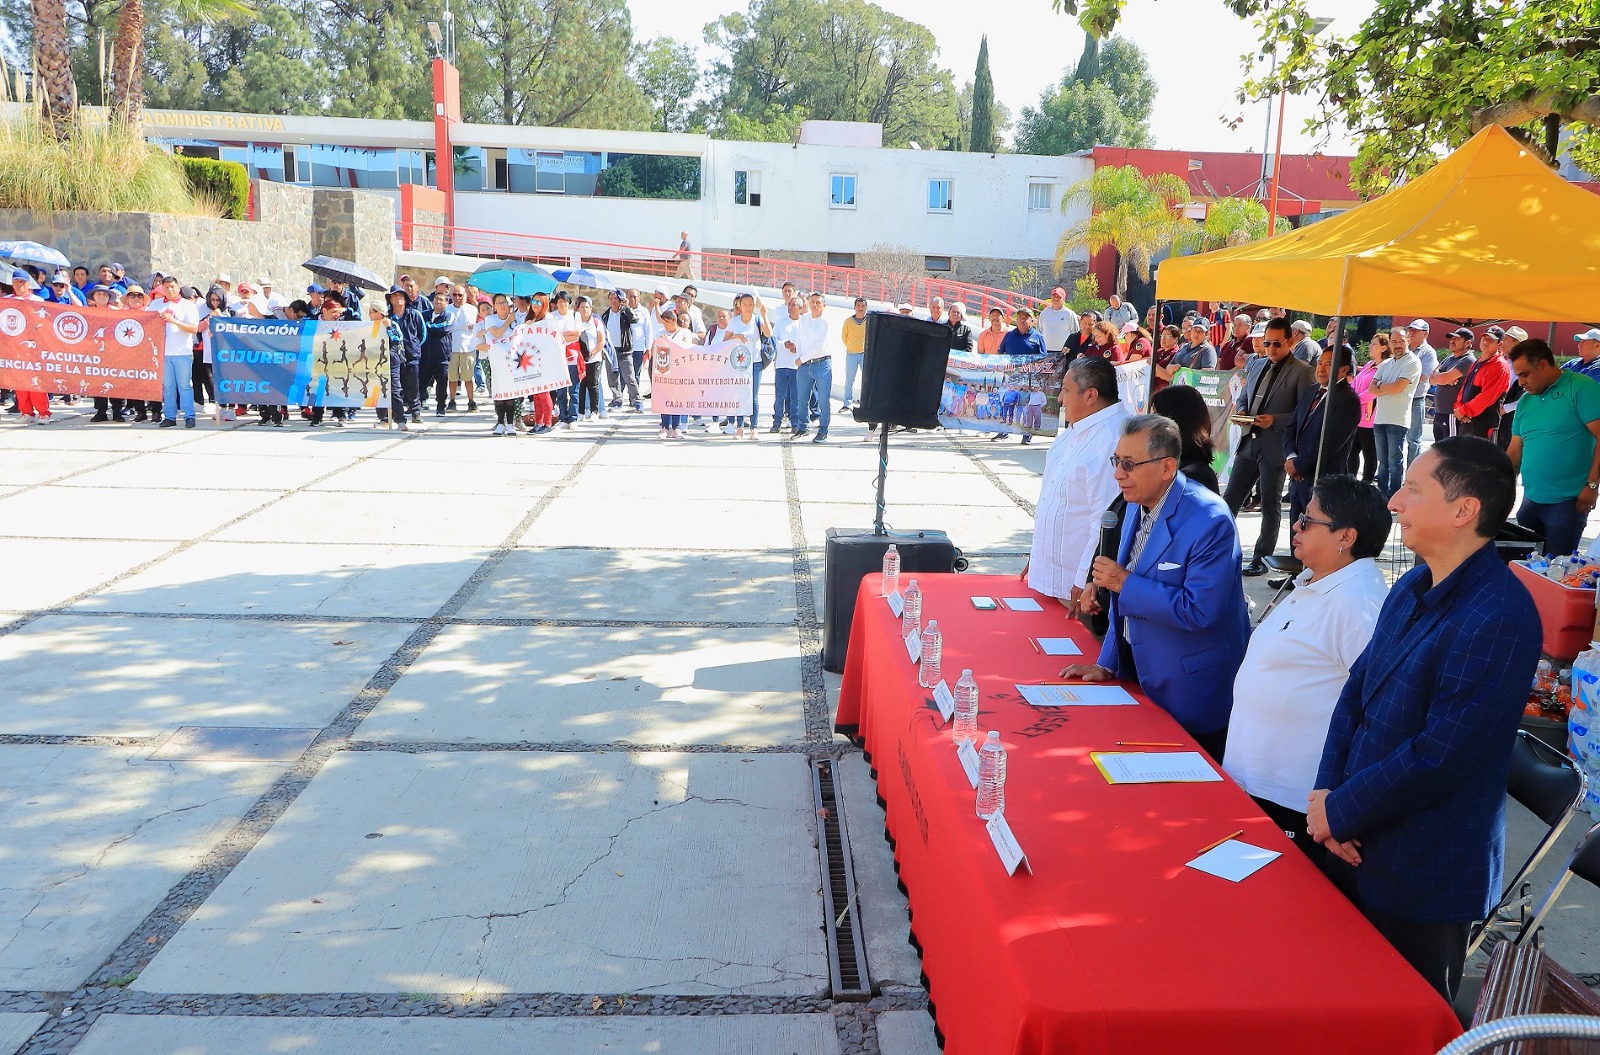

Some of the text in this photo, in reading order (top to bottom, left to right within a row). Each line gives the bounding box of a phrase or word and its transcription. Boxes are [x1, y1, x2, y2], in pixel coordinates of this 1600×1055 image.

[143, 111, 285, 131] ADMINISTRATIVA
[215, 322, 299, 336] DELEGACIÓN
[41, 350, 101, 364] FACULTAD
[217, 349, 297, 365] CIJUREP
[674, 353, 729, 366] STEIESET
[46, 363, 62, 373] DE
[66, 364, 81, 375] LA
[85, 366, 158, 380] EDUCACIÓN
[219, 379, 271, 394] CTBC
[654, 376, 751, 386] RESIDENCIA UNIVERSITARIA
[494, 379, 571, 398] ADMINISTRATIVA
[698, 401, 740, 409] SEMINARIOS
